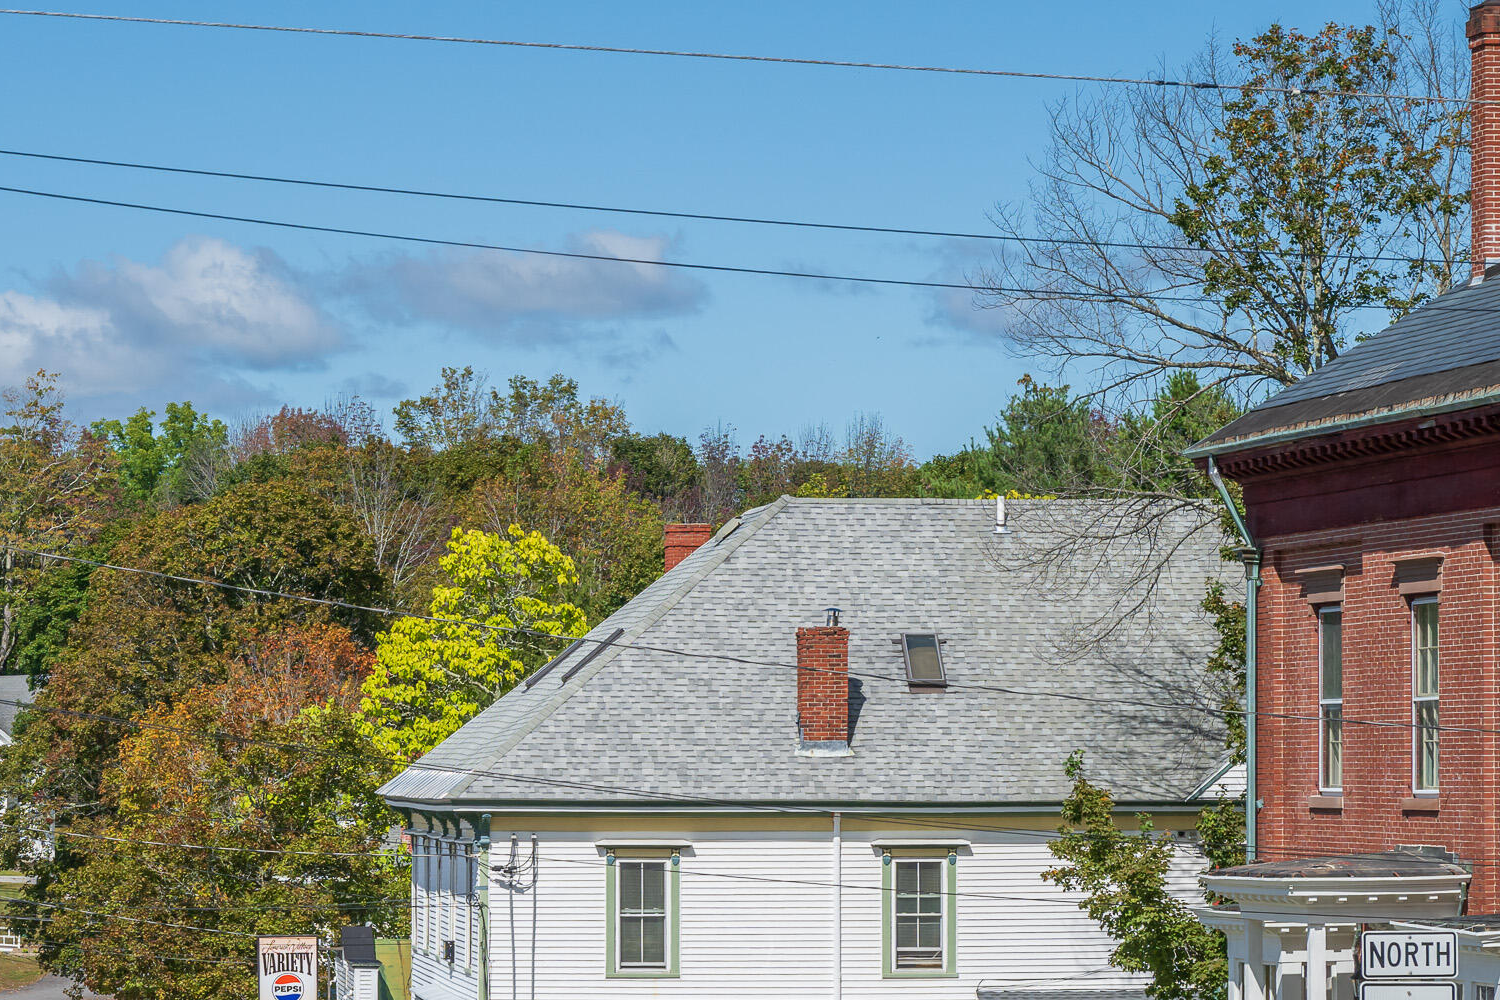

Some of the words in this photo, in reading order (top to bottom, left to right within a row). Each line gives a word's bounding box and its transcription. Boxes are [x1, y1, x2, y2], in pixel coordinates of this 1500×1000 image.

[262, 952, 313, 976] VARIETY
[1369, 941, 1451, 969] NORTH
[274, 985, 302, 993] PEPSI
